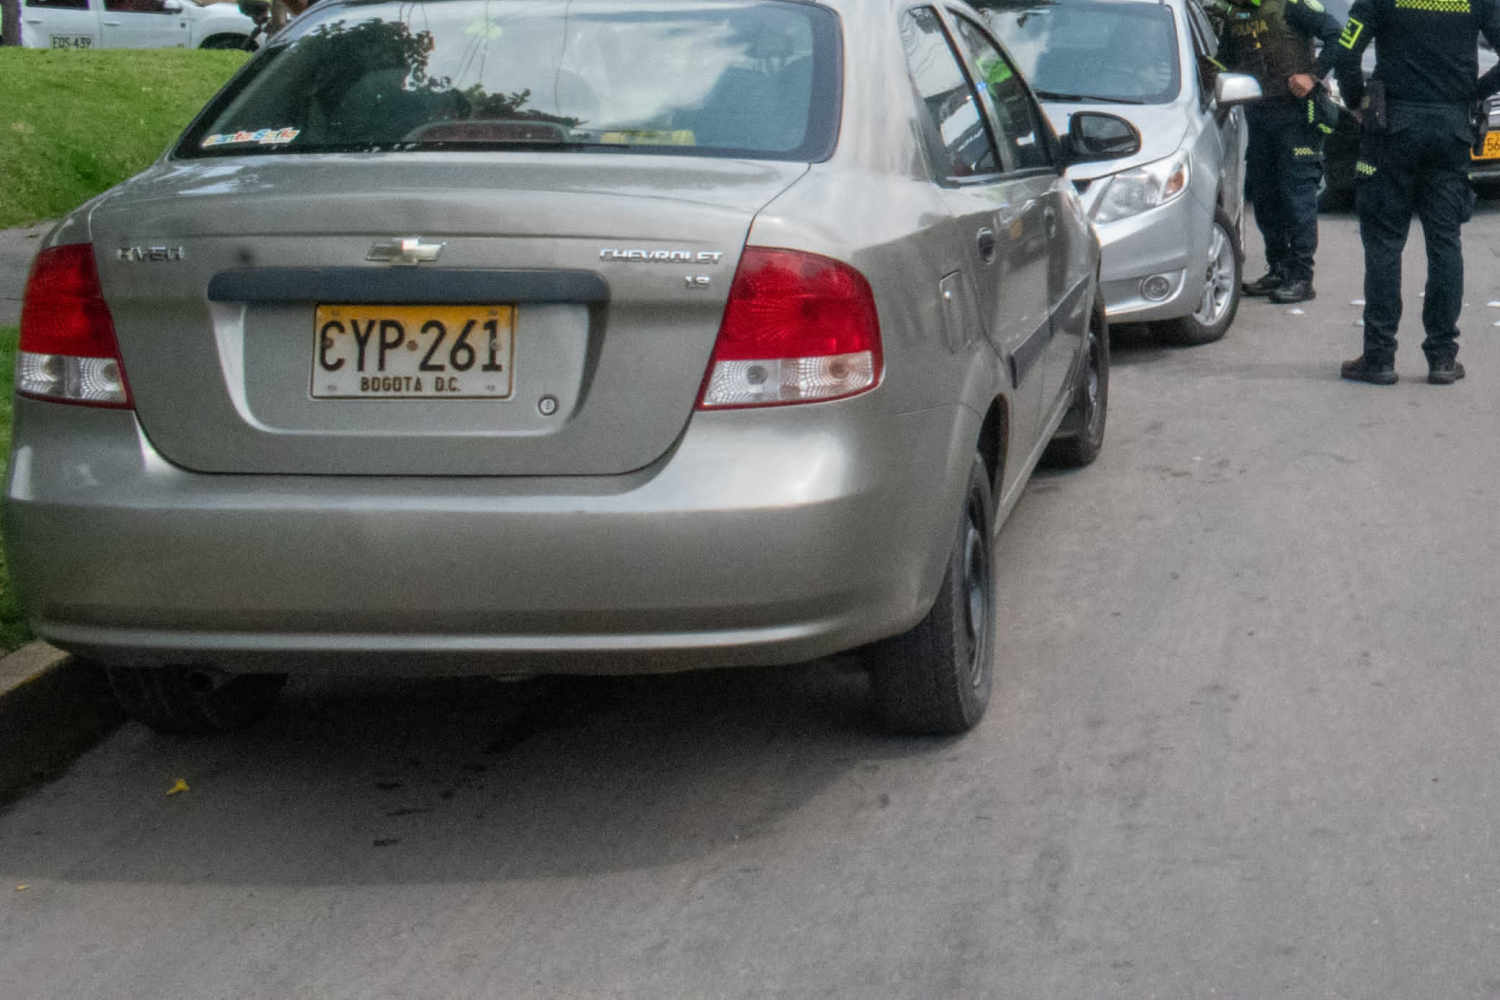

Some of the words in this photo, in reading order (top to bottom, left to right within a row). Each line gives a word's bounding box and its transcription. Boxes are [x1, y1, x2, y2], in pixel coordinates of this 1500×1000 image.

[600, 249, 723, 263] CHEVROLET
[361, 377, 422, 392] BOGOTA
[435, 377, 461, 392] D.C.
